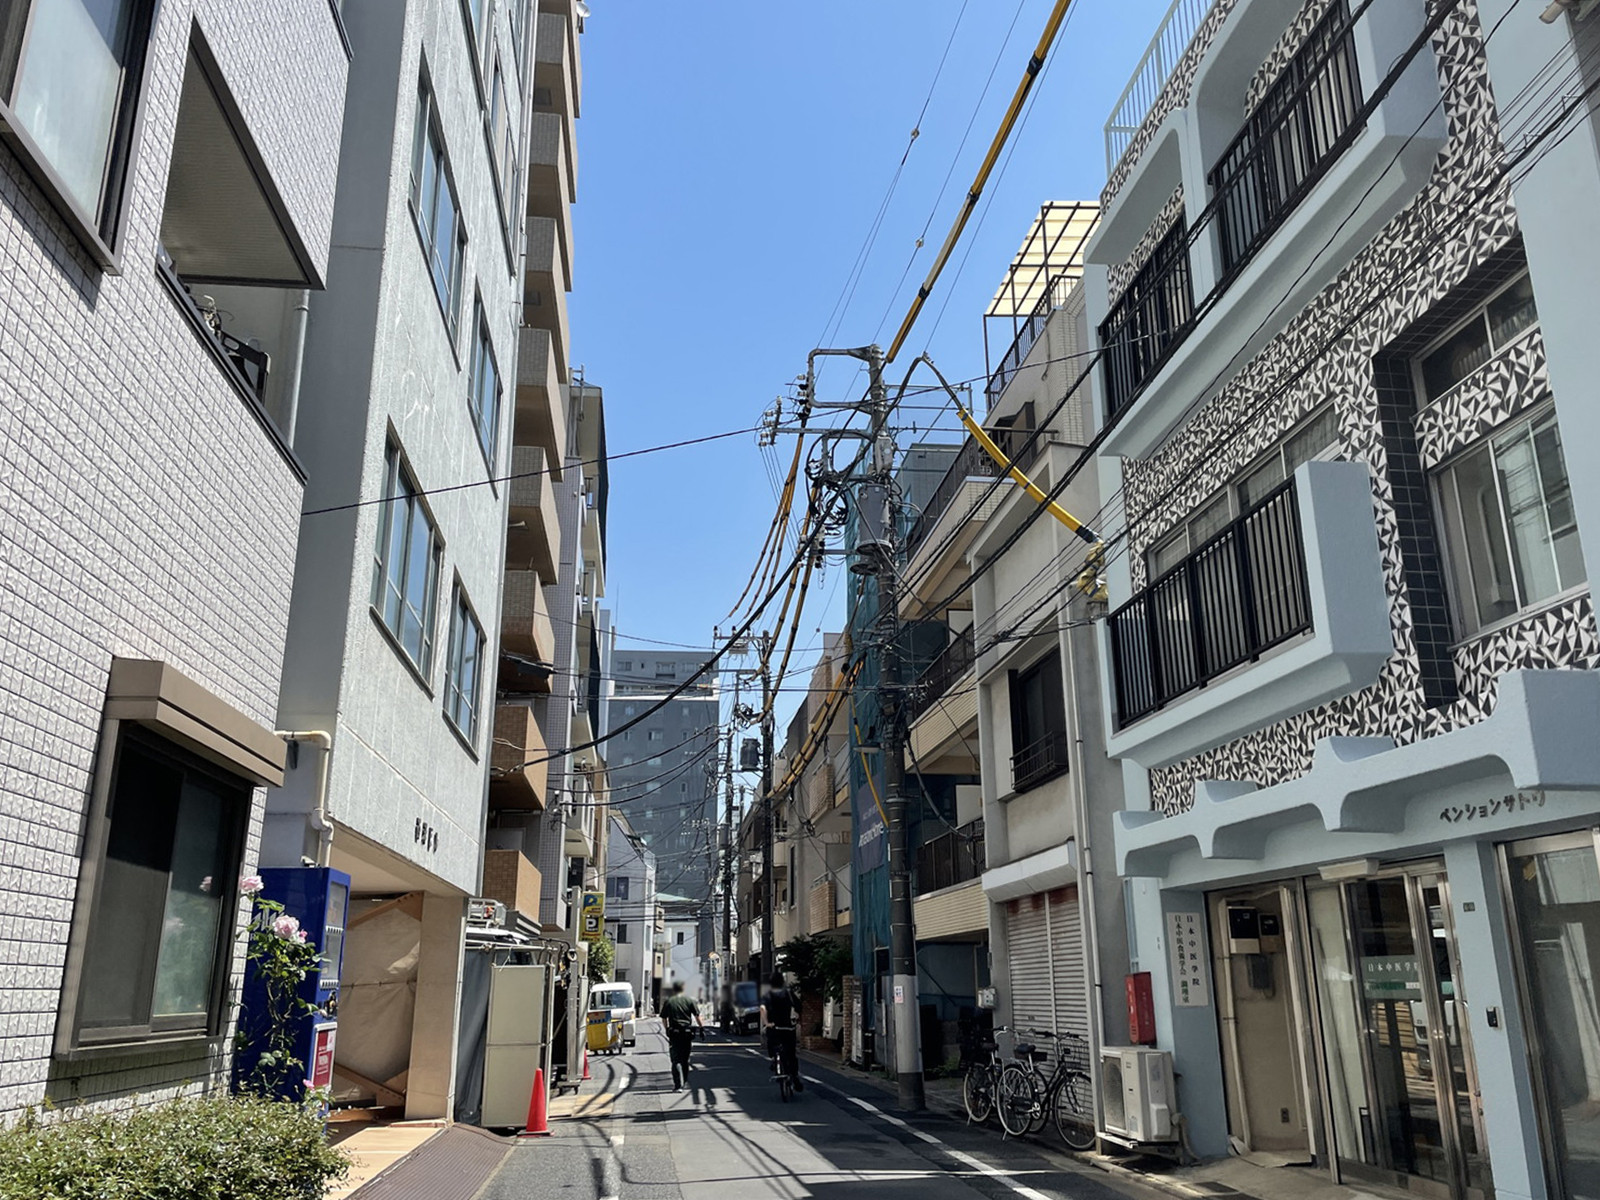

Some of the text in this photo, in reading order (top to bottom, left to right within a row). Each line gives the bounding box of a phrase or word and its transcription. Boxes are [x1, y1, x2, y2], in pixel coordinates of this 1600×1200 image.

[586, 918, 597, 931] P
[1186, 914, 1200, 986] 日本中医学院
